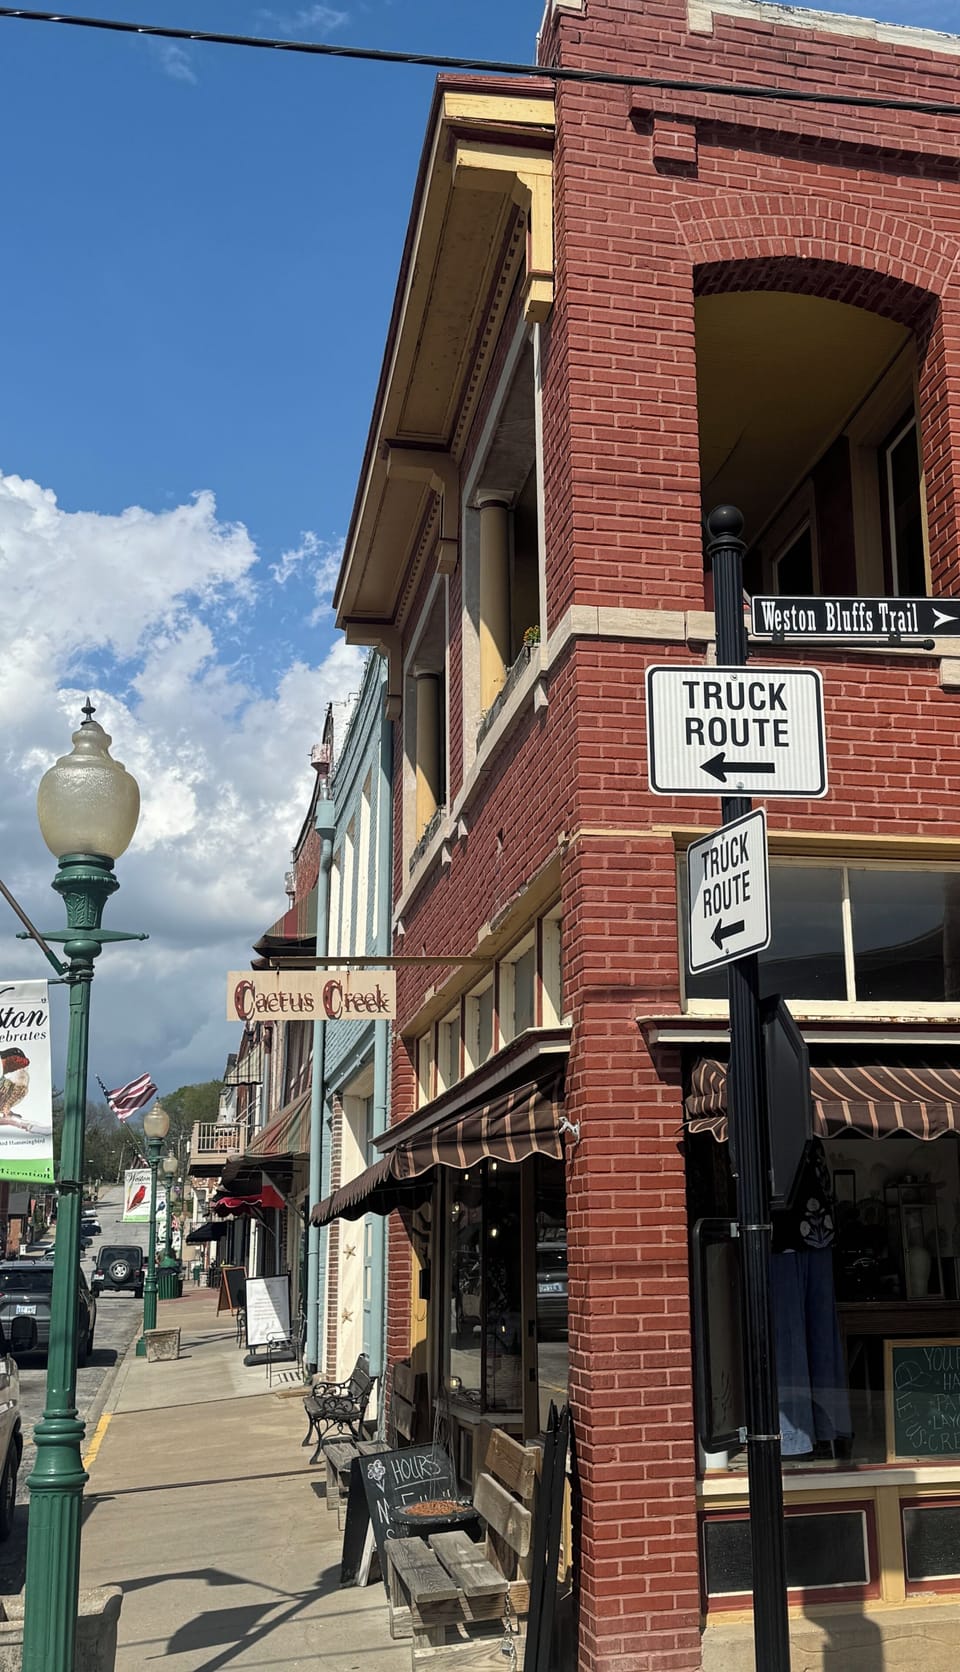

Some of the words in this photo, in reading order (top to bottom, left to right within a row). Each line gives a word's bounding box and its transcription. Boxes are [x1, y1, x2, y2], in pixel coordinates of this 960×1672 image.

[761, 601, 816, 631] Weston
[825, 602, 873, 631] Bluffs
[879, 603, 918, 632] Trail
[682, 681, 787, 711] TRUCK
[685, 717, 789, 747] ROUTE
[701, 831, 749, 880] TRUCK
[703, 870, 751, 918] ROUTE
[234, 980, 315, 1021] Cactus
[322, 980, 391, 1020] Creek
[390, 1455, 441, 1484] HOURS
